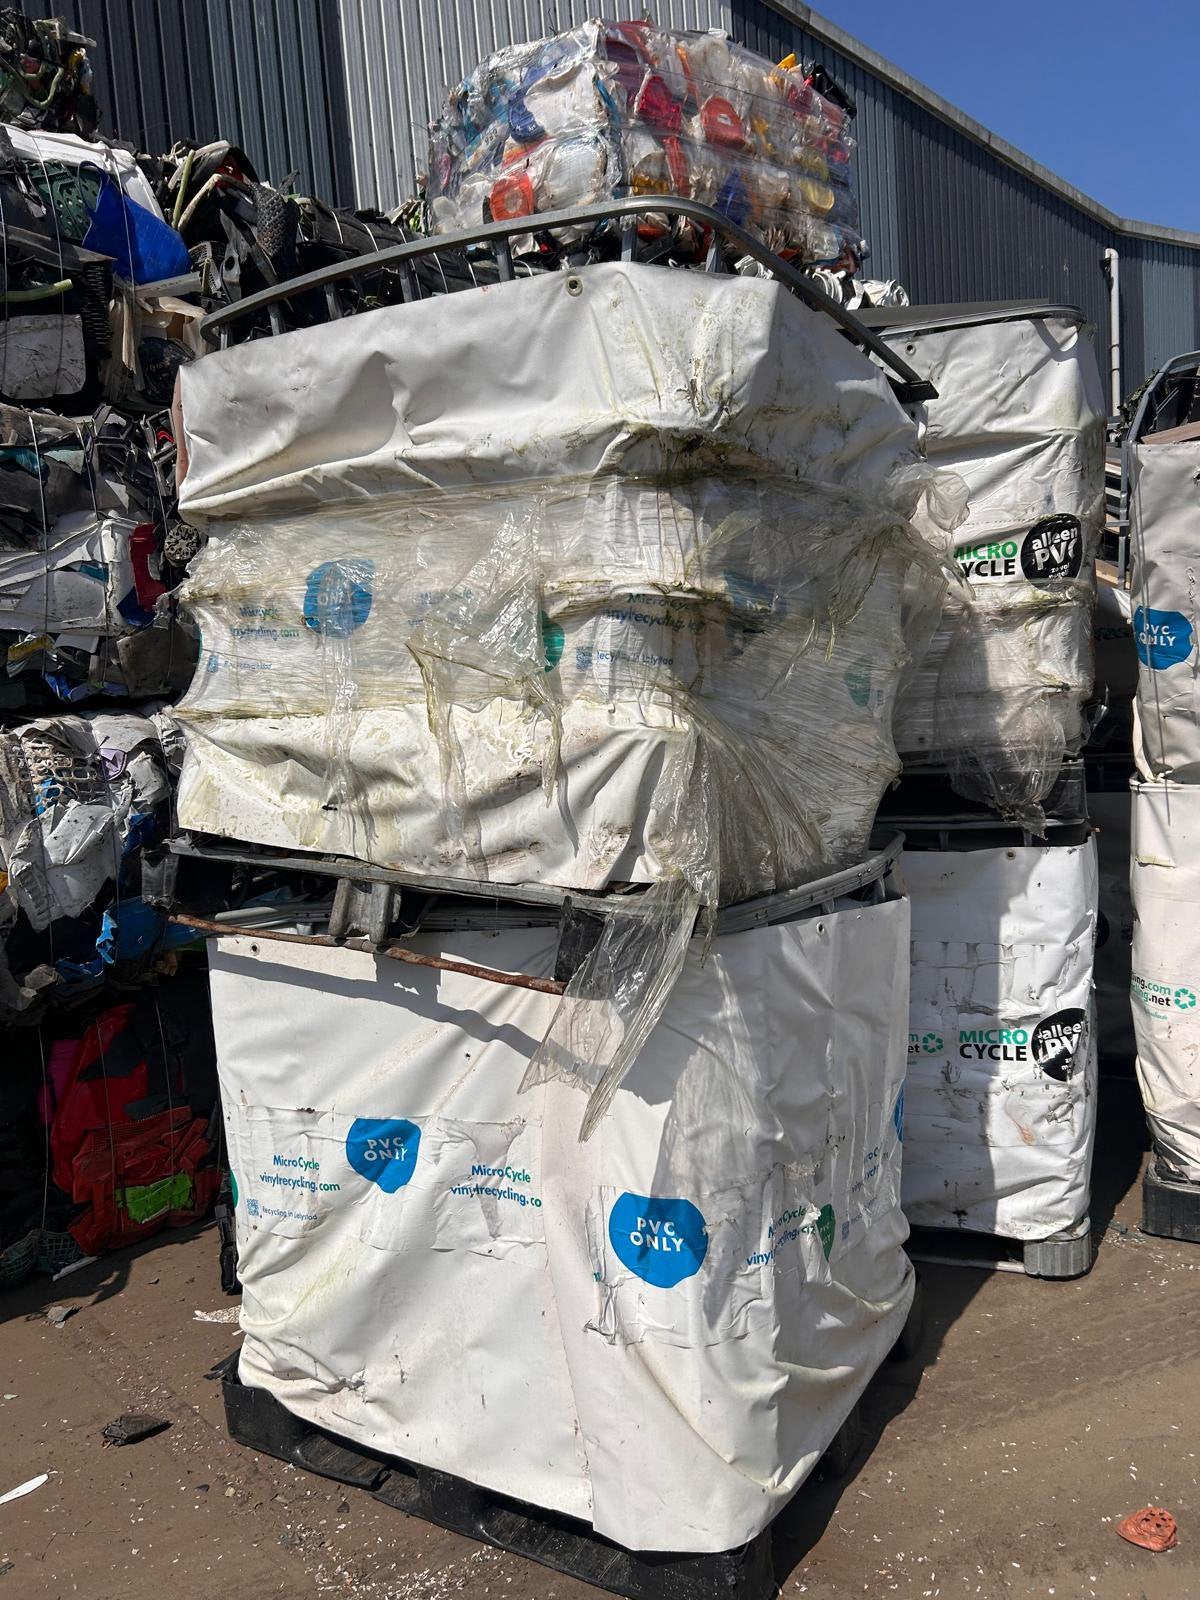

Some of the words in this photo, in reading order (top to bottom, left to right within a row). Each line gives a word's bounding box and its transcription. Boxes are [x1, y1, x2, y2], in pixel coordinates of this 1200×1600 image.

[1032, 527, 1078, 550] alleen
[961, 559, 1016, 577] YCLE
[1143, 623, 1170, 635] PVC
[1138, 632, 1177, 646] ONLY
[960, 1027, 1028, 1045] MICRO
[1041, 1020, 1083, 1040] allee
[960, 1043, 1028, 1061] CYCLE
[1043, 1033, 1079, 1060] PV
[367, 1136, 403, 1149] PVC
[273, 1155, 320, 1171] MicroCycle
[364, 1147, 408, 1162] ONLY
[260, 1171, 341, 1193] vinylrecycling.com
[471, 1165, 531, 1183] MicroCycle
[637, 1216, 675, 1237] PVC
[629, 1231, 684, 1253] ONLY
